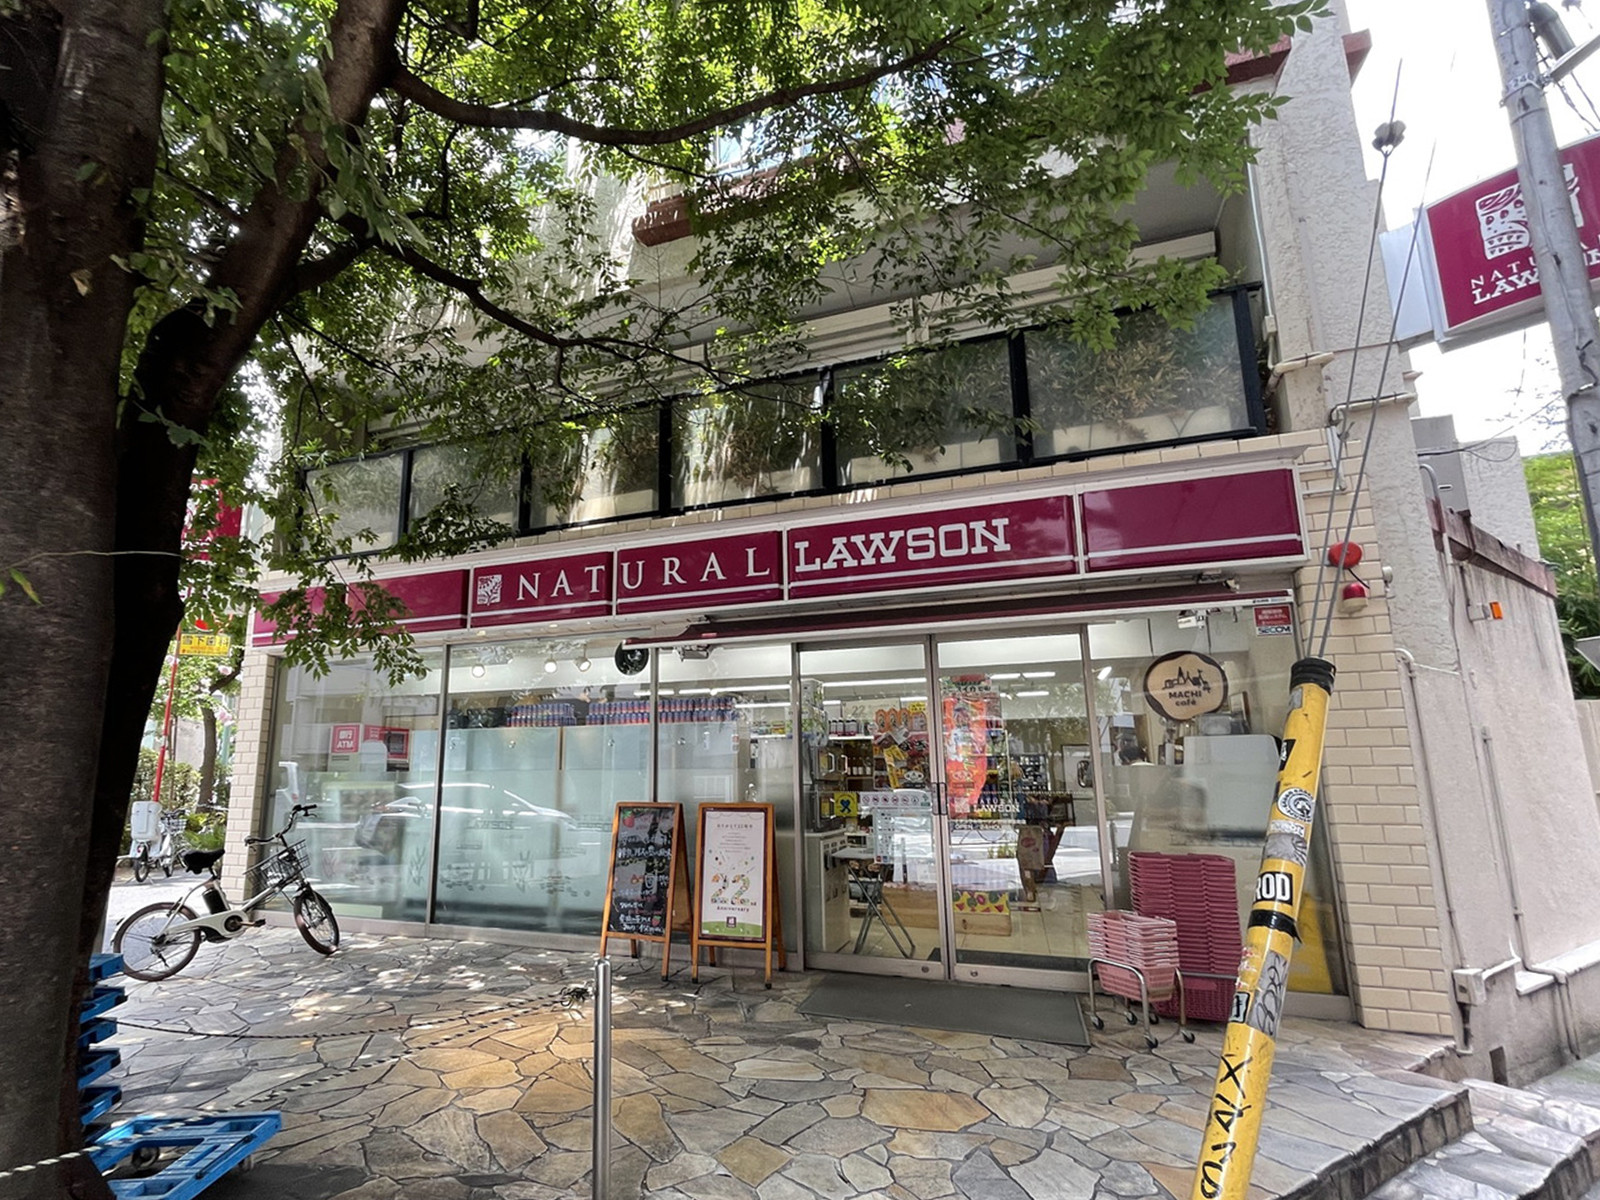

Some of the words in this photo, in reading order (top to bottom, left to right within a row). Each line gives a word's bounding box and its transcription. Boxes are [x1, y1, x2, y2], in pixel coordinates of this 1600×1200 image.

[517, 547, 770, 601] NATURAL
[795, 518, 1012, 573] LAWSON
[1168, 690, 1203, 699] MACHI
[1175, 697, 1197, 707] café
[336, 740, 355, 749] ATM
[973, 804, 1020, 813] LAWSON
